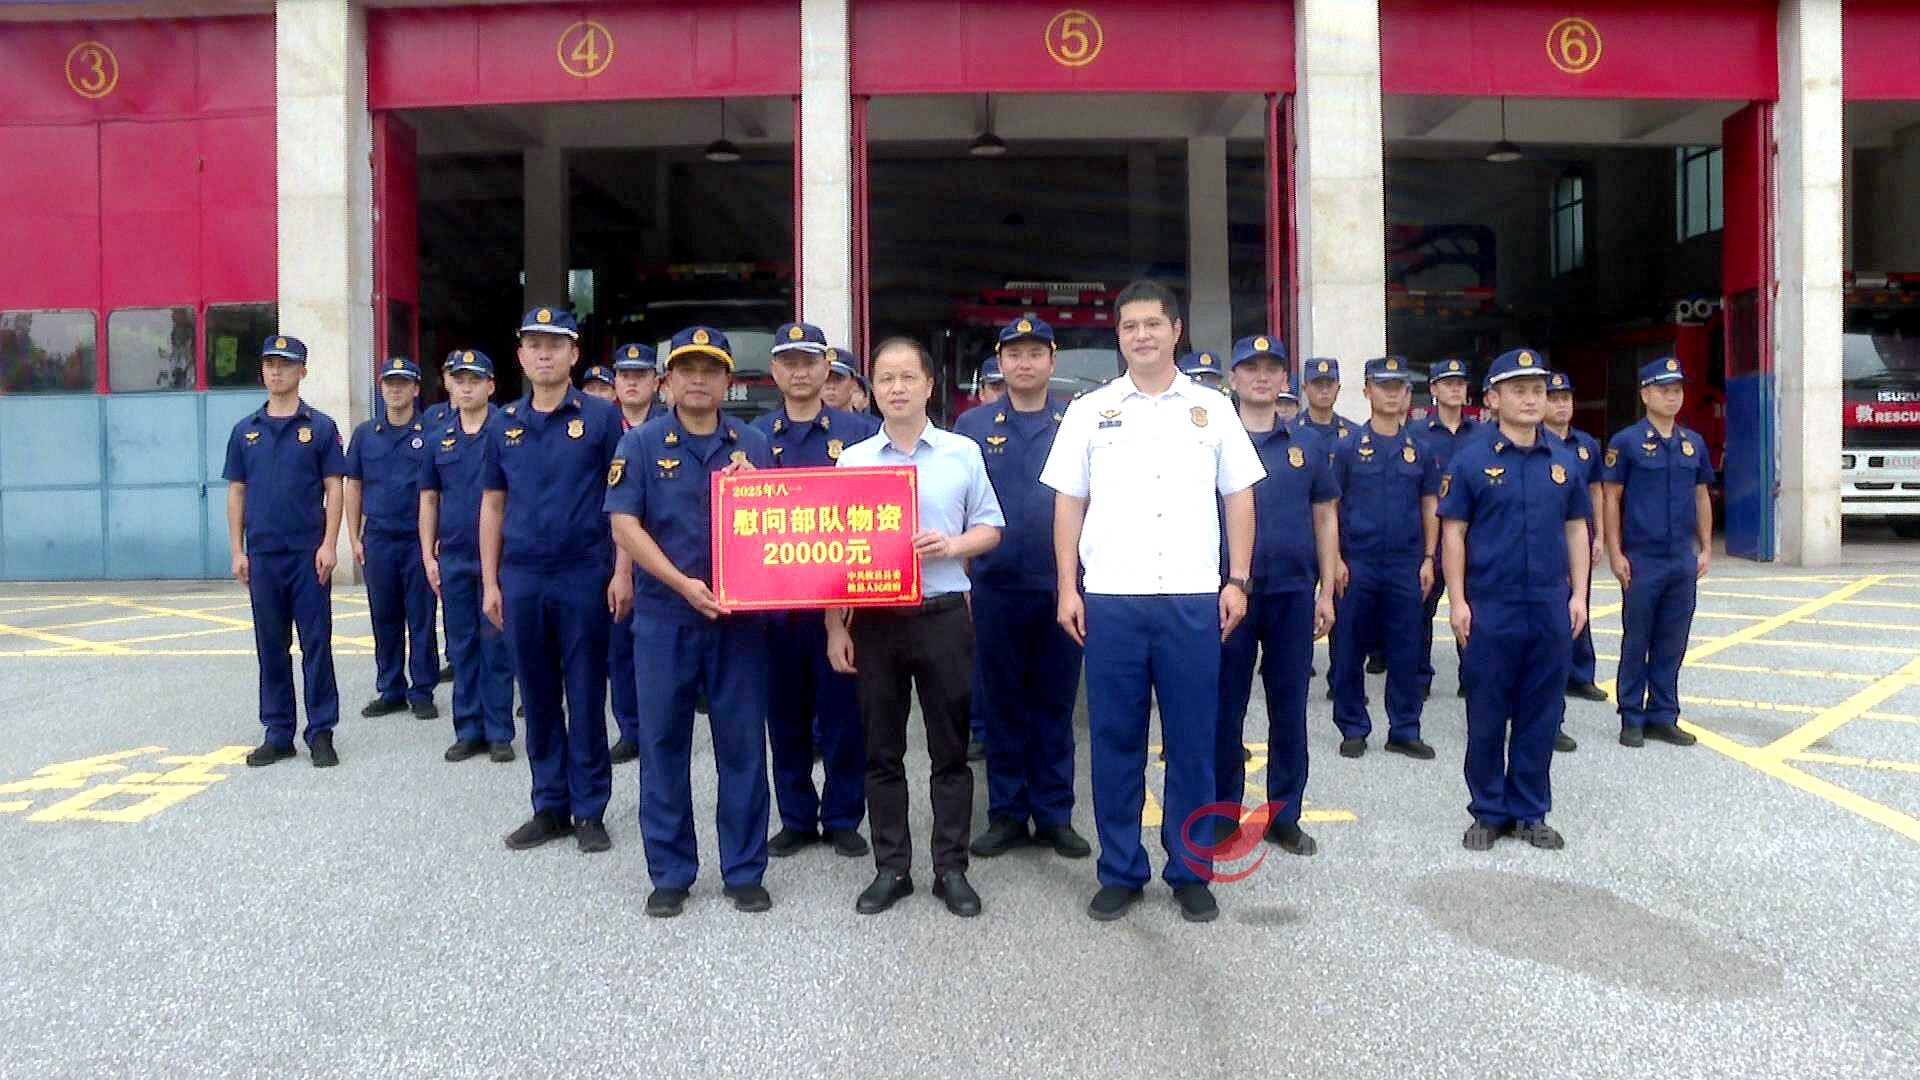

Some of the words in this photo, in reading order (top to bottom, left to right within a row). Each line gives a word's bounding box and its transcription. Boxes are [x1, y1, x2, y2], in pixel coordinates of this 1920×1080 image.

[1874, 410, 1920, 423] RESCU
[733, 504, 902, 536] 慰问部队物资
[763, 538, 873, 566] 20000元
